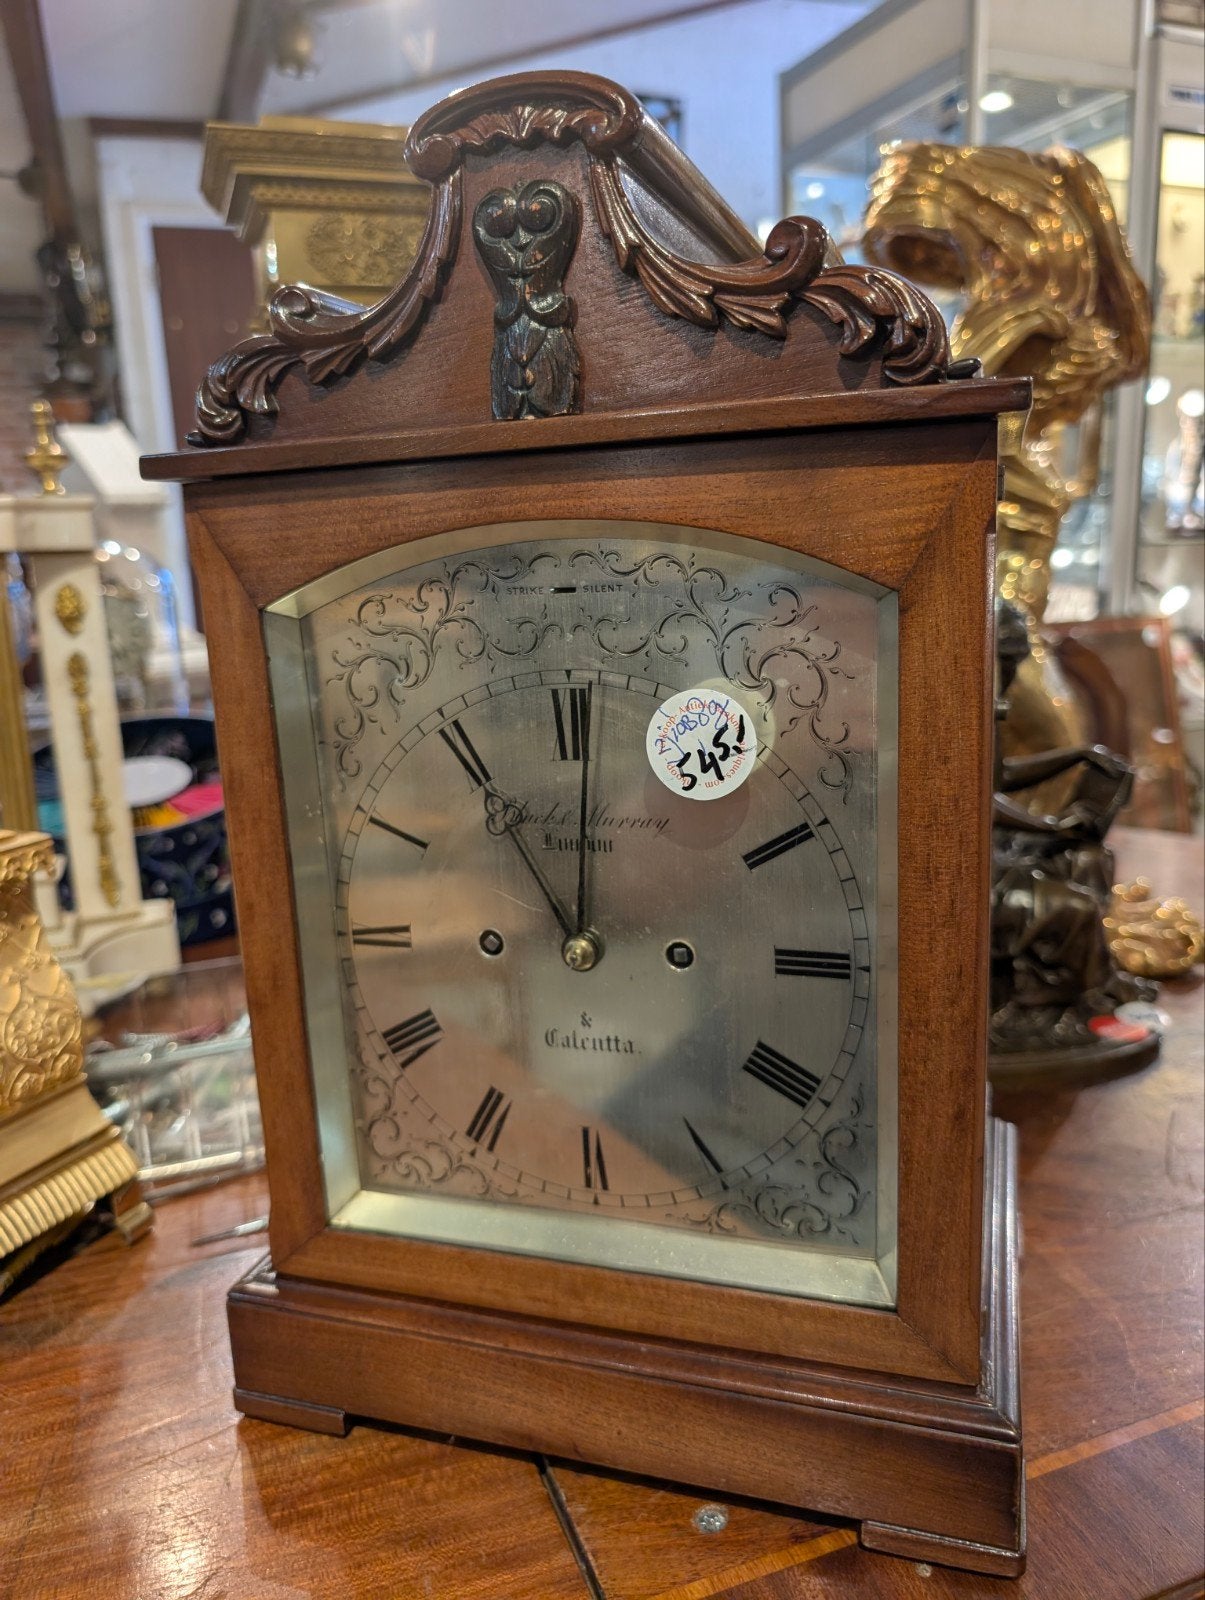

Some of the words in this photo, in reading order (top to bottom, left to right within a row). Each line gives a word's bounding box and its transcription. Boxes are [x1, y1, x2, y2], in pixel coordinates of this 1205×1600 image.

[506, 586, 544, 596] STRIKE
[582, 584, 623, 594] SILENT
[548, 687, 592, 761] XII
[436, 717, 496, 795] XI
[584, 802, 671, 839] Murray
[739, 819, 818, 873] II
[351, 920, 413, 951] IX
[773, 945, 852, 981] III
[382, 1006, 444, 1070] VIII
[580, 1011, 592, 1029] &
[741, 1038, 824, 1110] IIII
[465, 1085, 514, 1153] VII
[579, 1124, 610, 1192] VI
